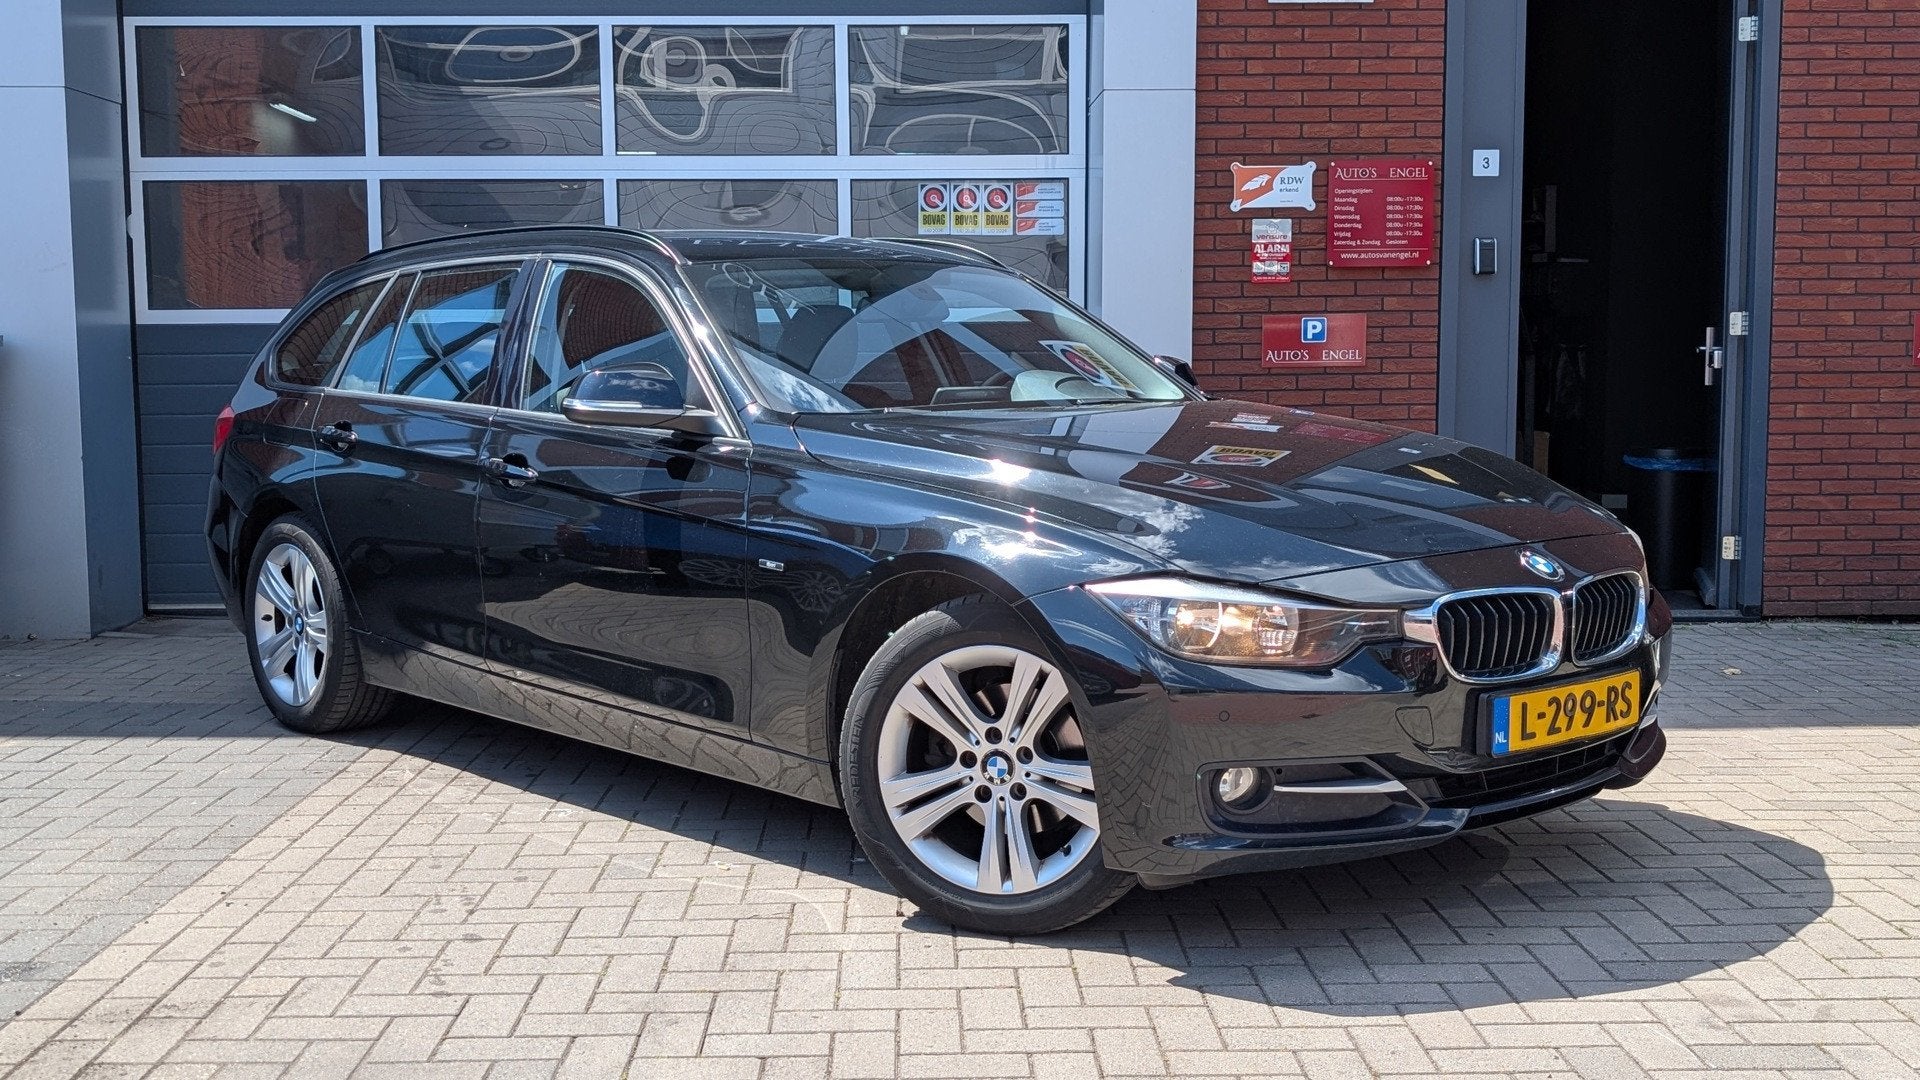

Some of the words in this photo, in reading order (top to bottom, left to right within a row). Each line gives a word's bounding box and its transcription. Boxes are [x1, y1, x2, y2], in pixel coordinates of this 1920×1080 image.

[1482, 157, 1490, 169] 3
[1335, 168, 1377, 179] AUTO'S
[1390, 167, 1428, 178] ENGEL
[923, 214, 945, 225] BOVAG
[955, 214, 978, 226] BOVAG
[986, 215, 1009, 226] BOVAG
[1254, 244, 1290, 253] ALARM
[1307, 321, 1322, 339] P
[1266, 350, 1309, 361] AUTO'S
[1322, 350, 1362, 360] ENGEL
[1521, 681, 1632, 740] L-299-RS
[1496, 732, 1506, 744] NL
